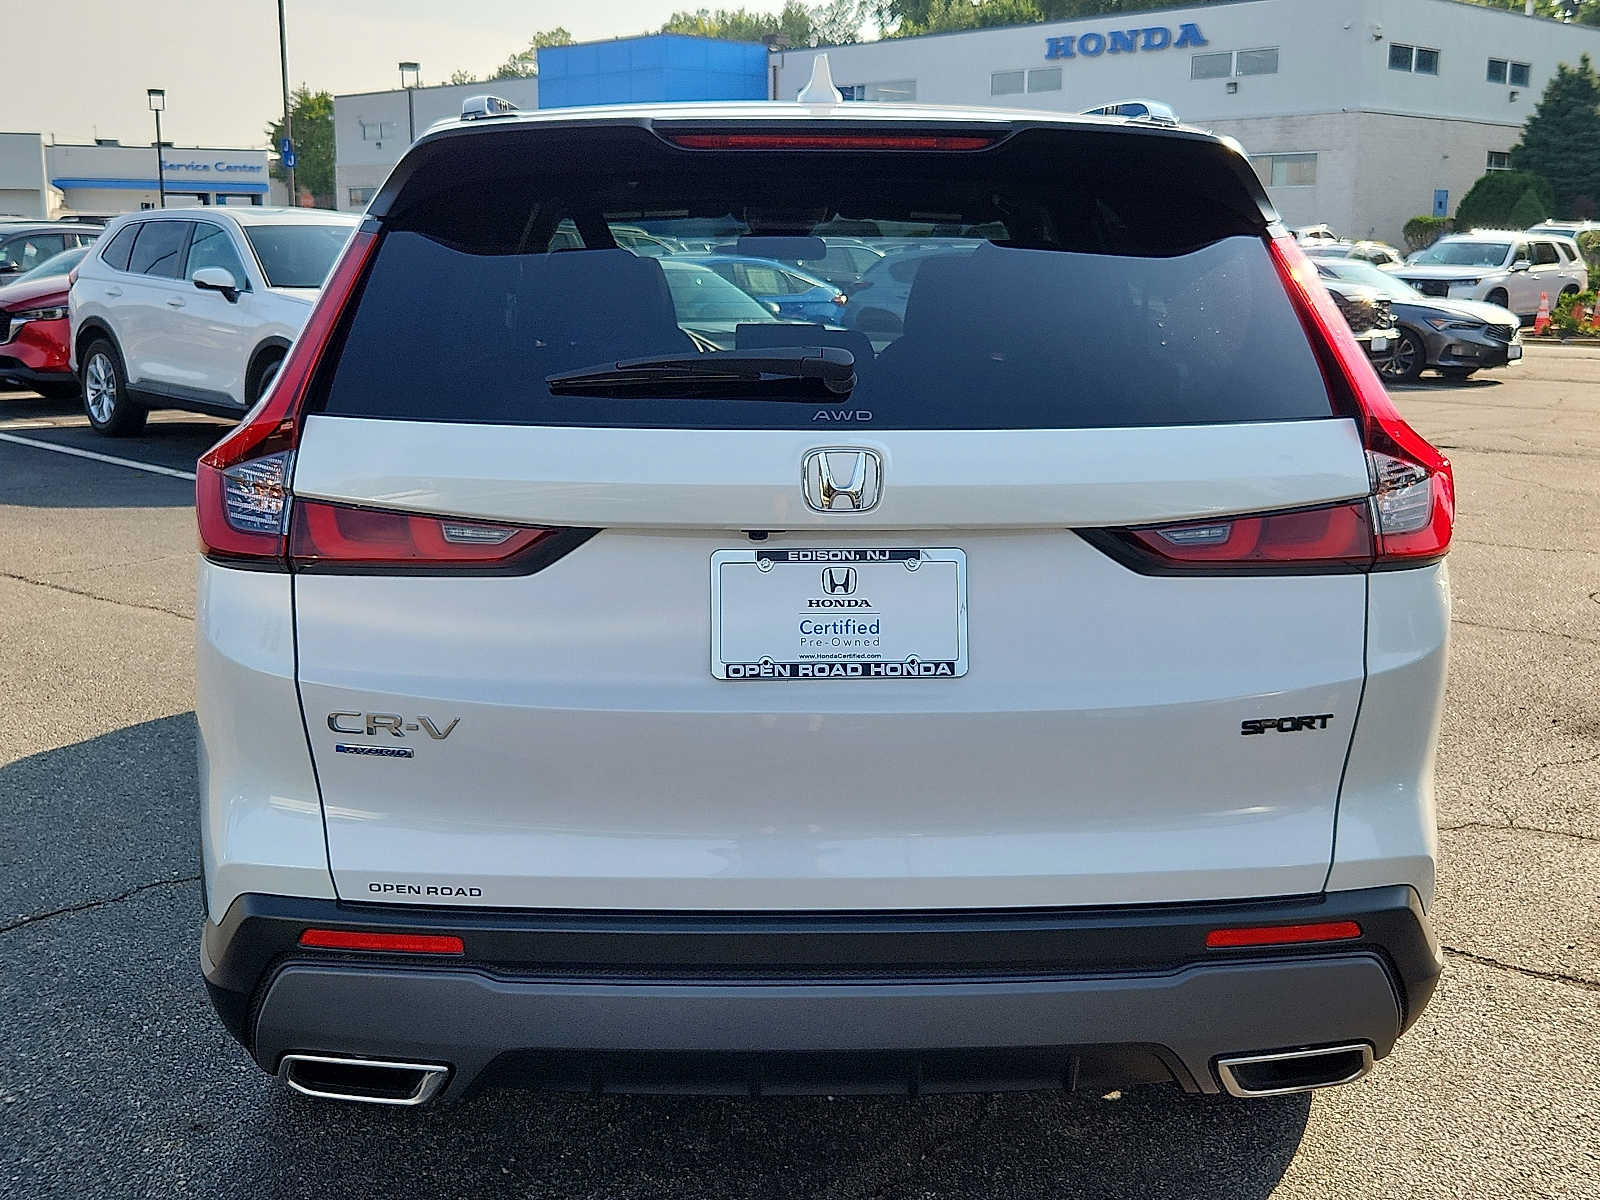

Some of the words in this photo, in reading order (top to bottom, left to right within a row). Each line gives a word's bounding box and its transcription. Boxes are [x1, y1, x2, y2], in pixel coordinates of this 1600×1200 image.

[1045, 23, 1208, 60] HONDA
[161, 160, 210, 172] Service
[214, 161, 263, 173] Center
[812, 410, 873, 422] AWD
[788, 551, 860, 561] EDISON,
[867, 550, 890, 561] NJ
[807, 599, 872, 608] HONDA
[799, 618, 880, 636] Certified
[800, 638, 880, 647] Pre-Owned
[728, 664, 790, 679] OPEN
[798, 664, 865, 678] ROAD
[871, 662, 953, 677] HONDA
[327, 711, 461, 740] CR-V
[1241, 713, 1335, 735] SPORT
[345, 747, 409, 758] HYBRID
[368, 882, 421, 895] OPEN
[426, 886, 482, 897] ROAD
